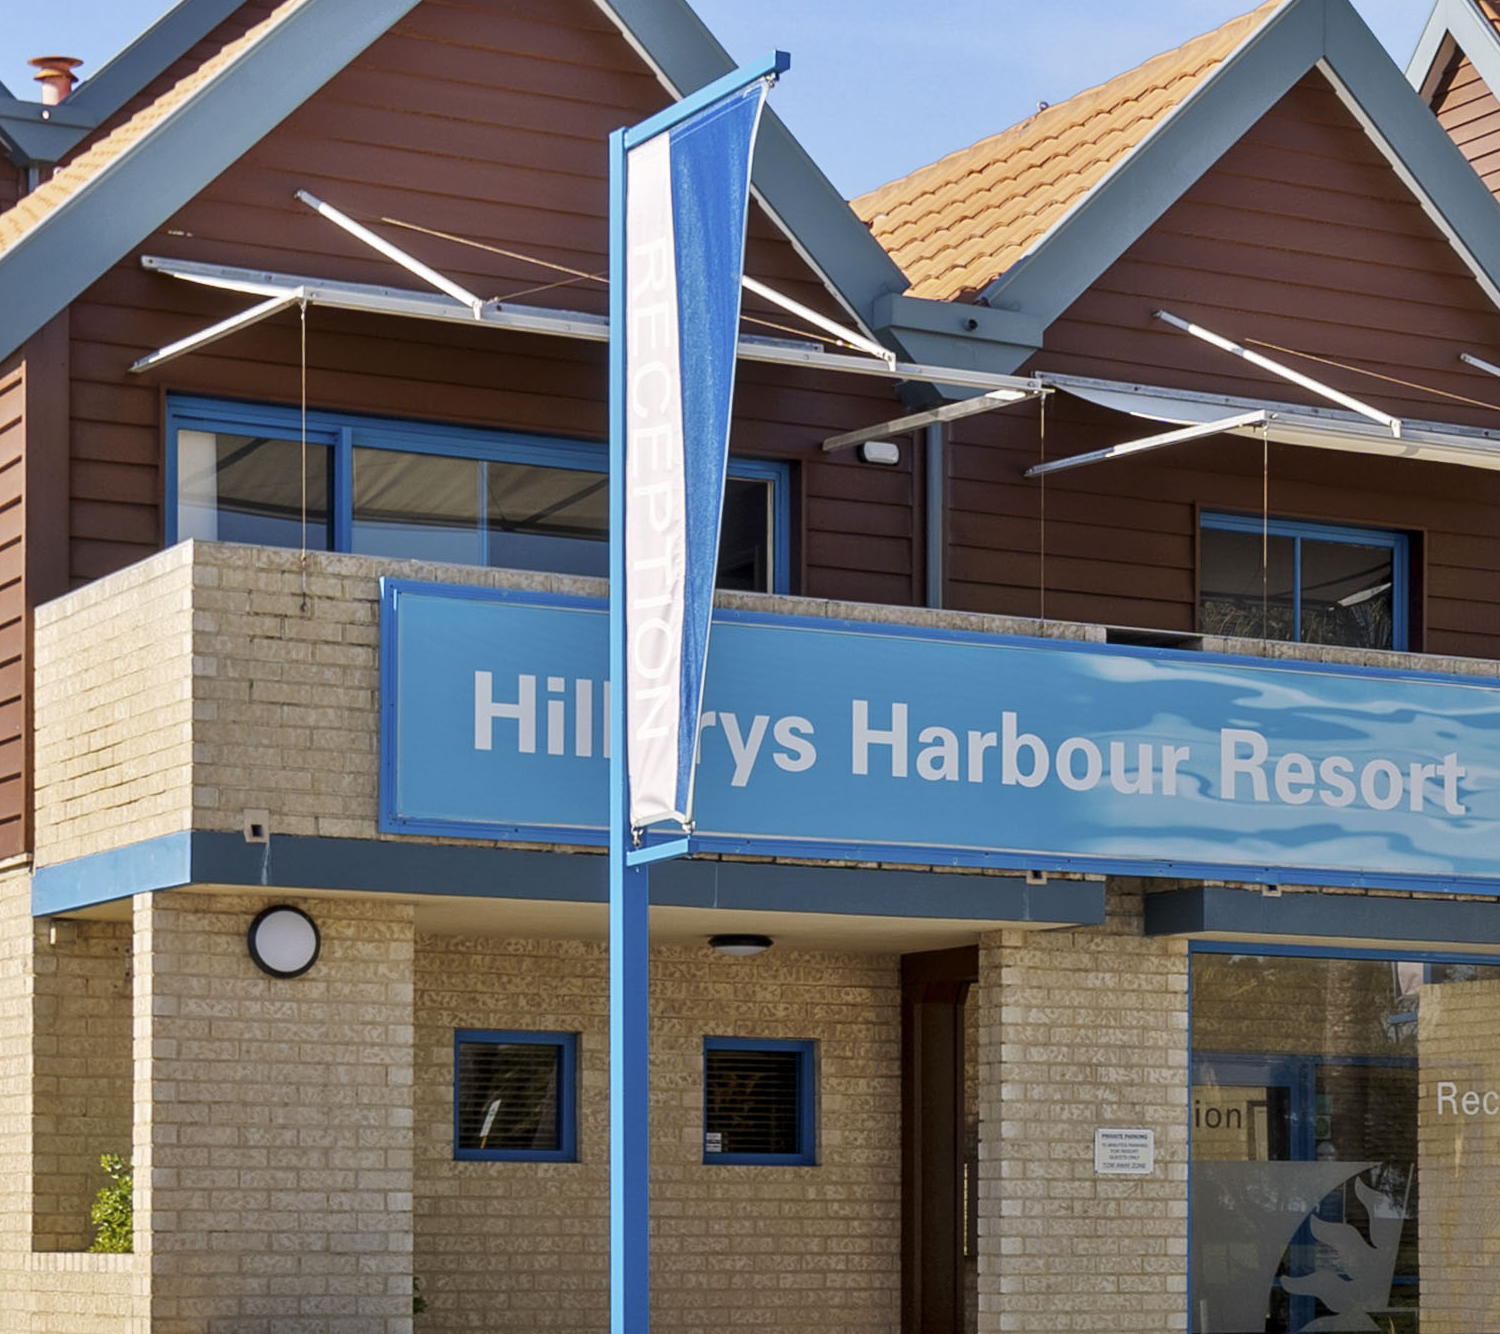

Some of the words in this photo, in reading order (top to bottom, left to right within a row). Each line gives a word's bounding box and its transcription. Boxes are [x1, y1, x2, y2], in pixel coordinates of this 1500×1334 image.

[632, 236, 674, 741] RECEPTION
[474, 670, 817, 787] Hilrys
[852, 699, 1190, 796] Harbour
[1220, 728, 1466, 816] Resort
